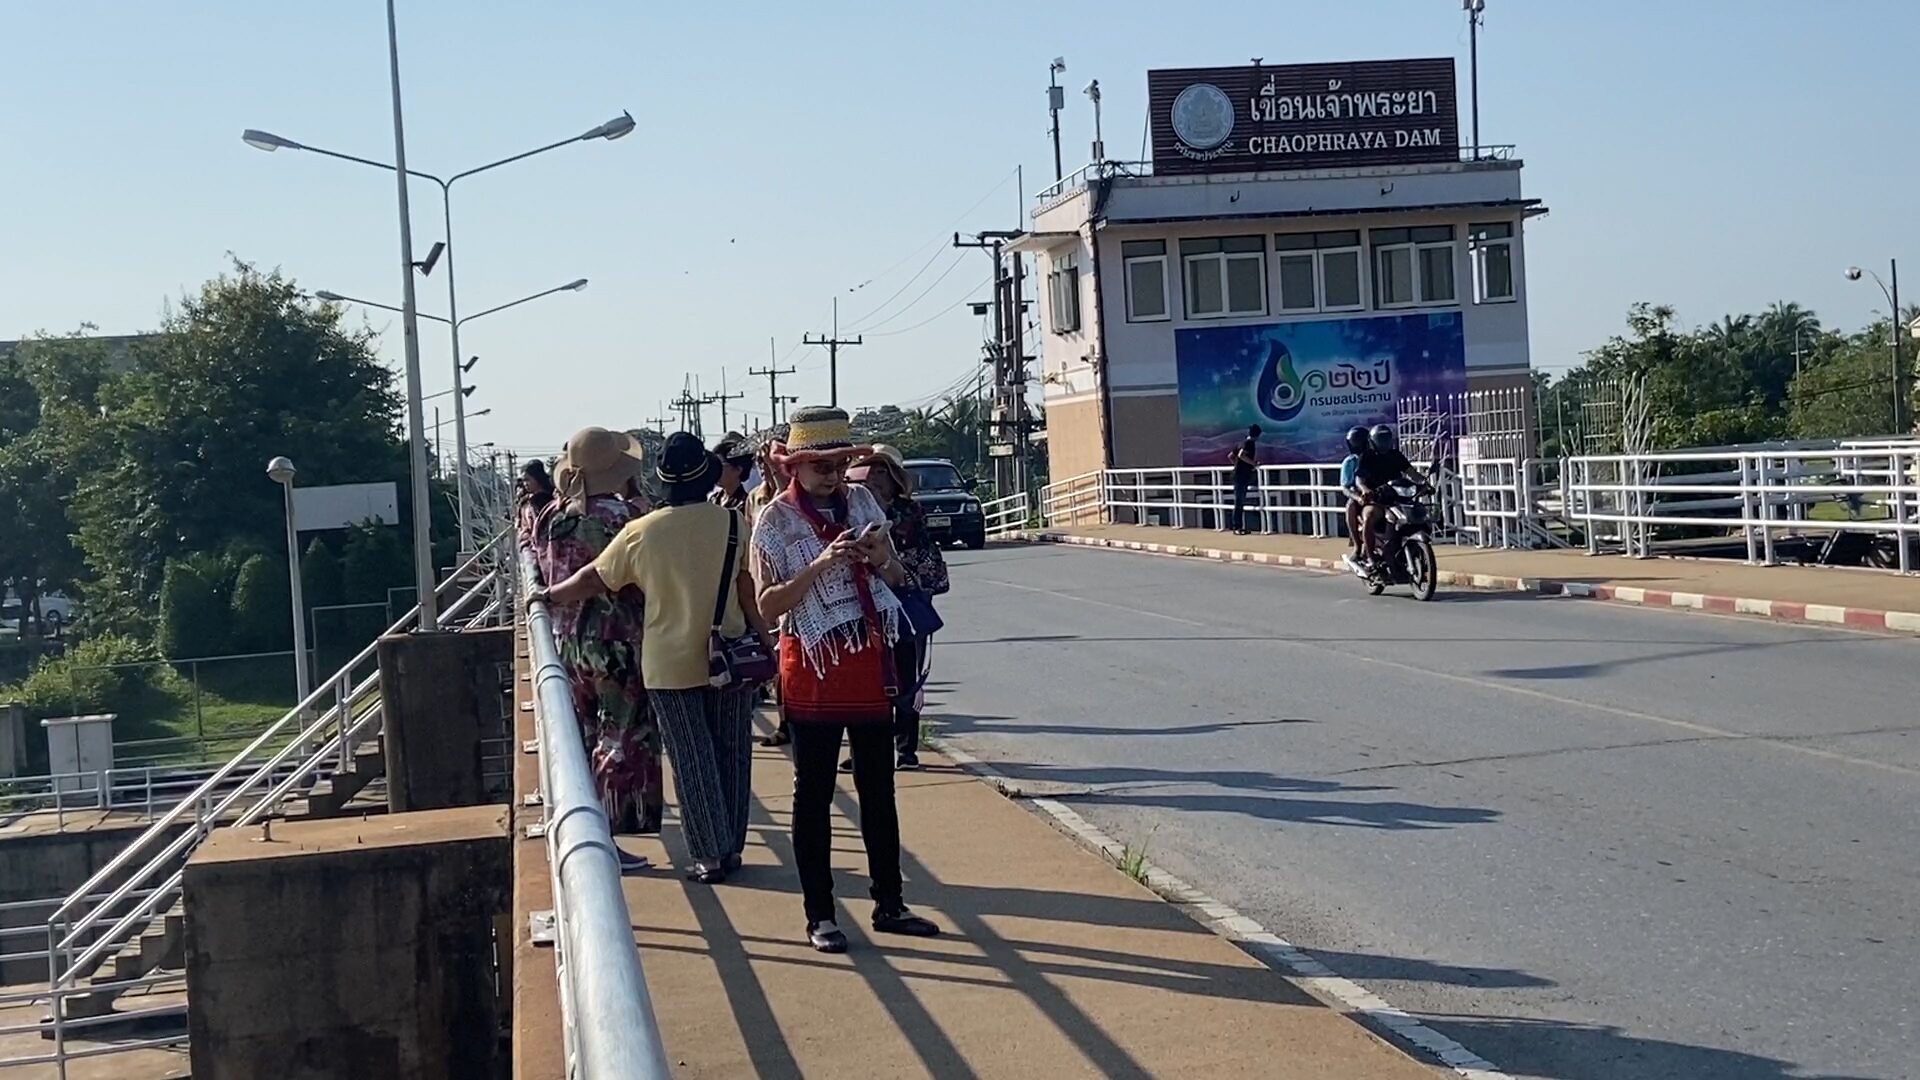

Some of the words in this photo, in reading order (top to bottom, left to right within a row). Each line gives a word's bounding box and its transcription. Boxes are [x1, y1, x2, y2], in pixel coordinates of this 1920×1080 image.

[1250, 74, 1437, 121] เขื่อนเจ้าพระยา
[1249, 131, 1387, 154] CHAOPHRAYA
[1395, 129, 1441, 148] DAM
[1310, 392, 1391, 407] กรมชลประทาน
